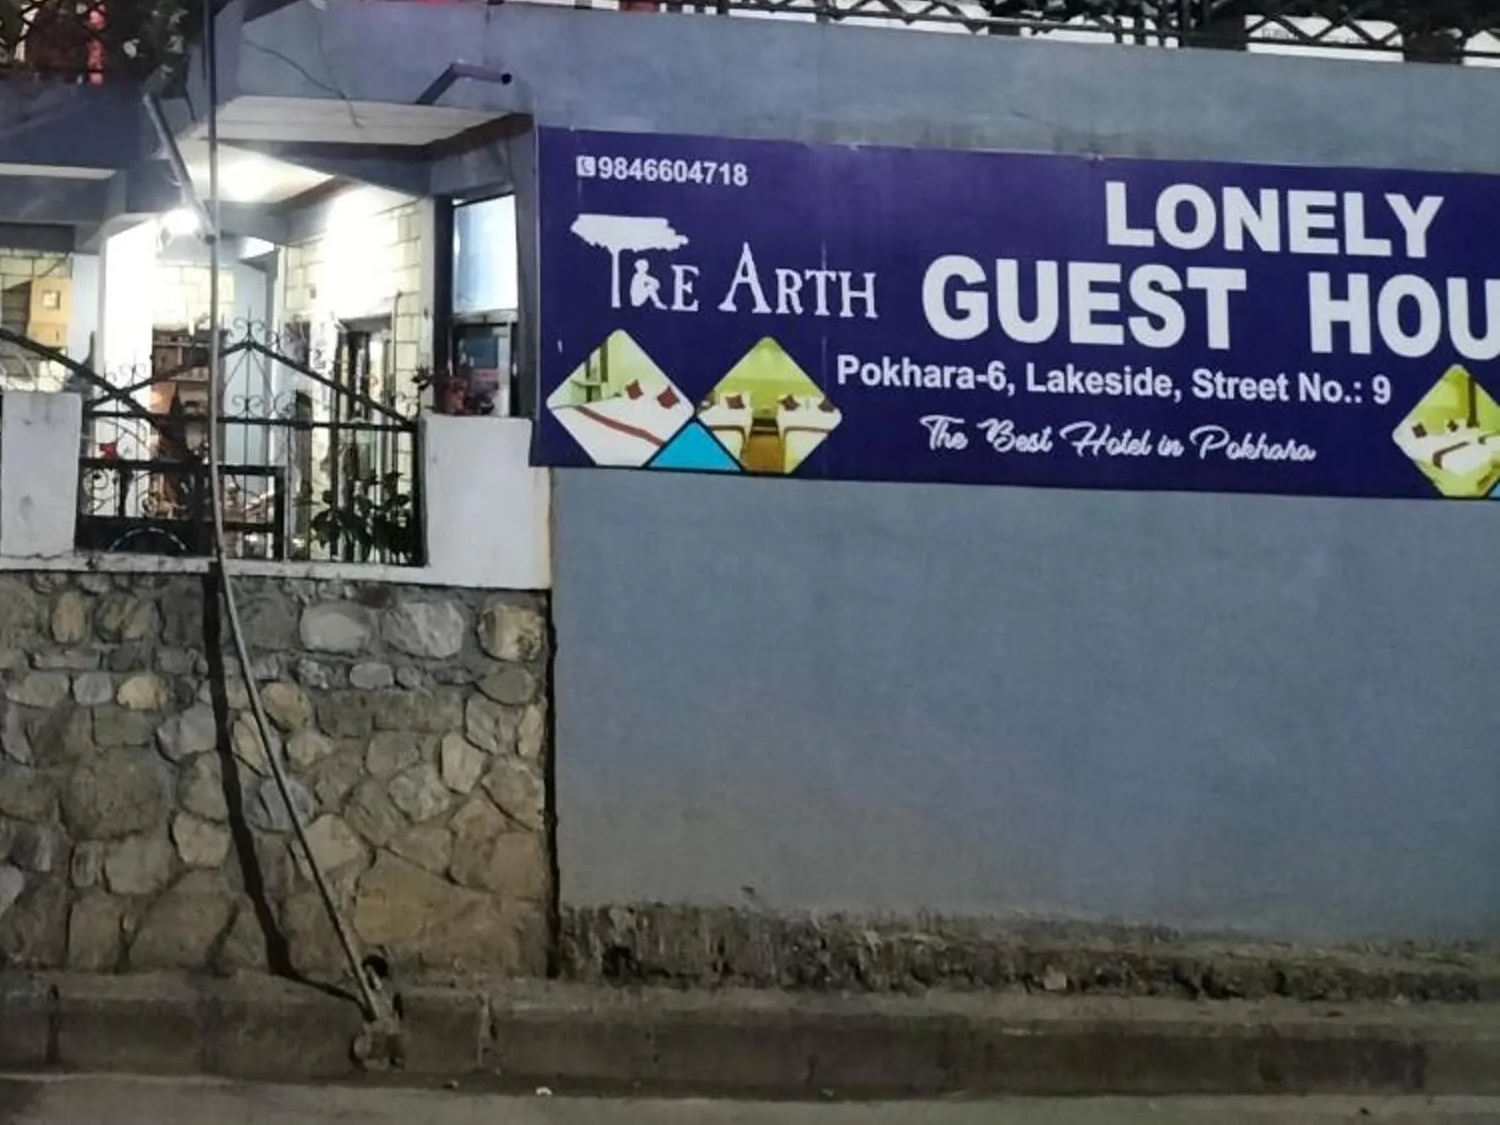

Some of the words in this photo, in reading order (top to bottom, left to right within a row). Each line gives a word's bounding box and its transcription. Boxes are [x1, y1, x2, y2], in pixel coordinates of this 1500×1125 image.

[598, 157, 748, 186] 9846604718
[1106, 181, 1444, 258] LONELY
[923, 255, 1246, 349] GUEST
[838, 355, 1014, 396] Pokhara-6,
[1027, 363, 1181, 402] Lakeside,
[1192, 369, 1289, 401] Street
[1299, 372, 1361, 403] No.:
[1373, 375, 1391, 404] 9
[920, 415, 968, 449] The
[977, 419, 1053, 452] Best
[1060, 421, 1152, 456] Hotel
[1158, 435, 1184, 456] in
[1190, 425, 1316, 461] Pokhara
